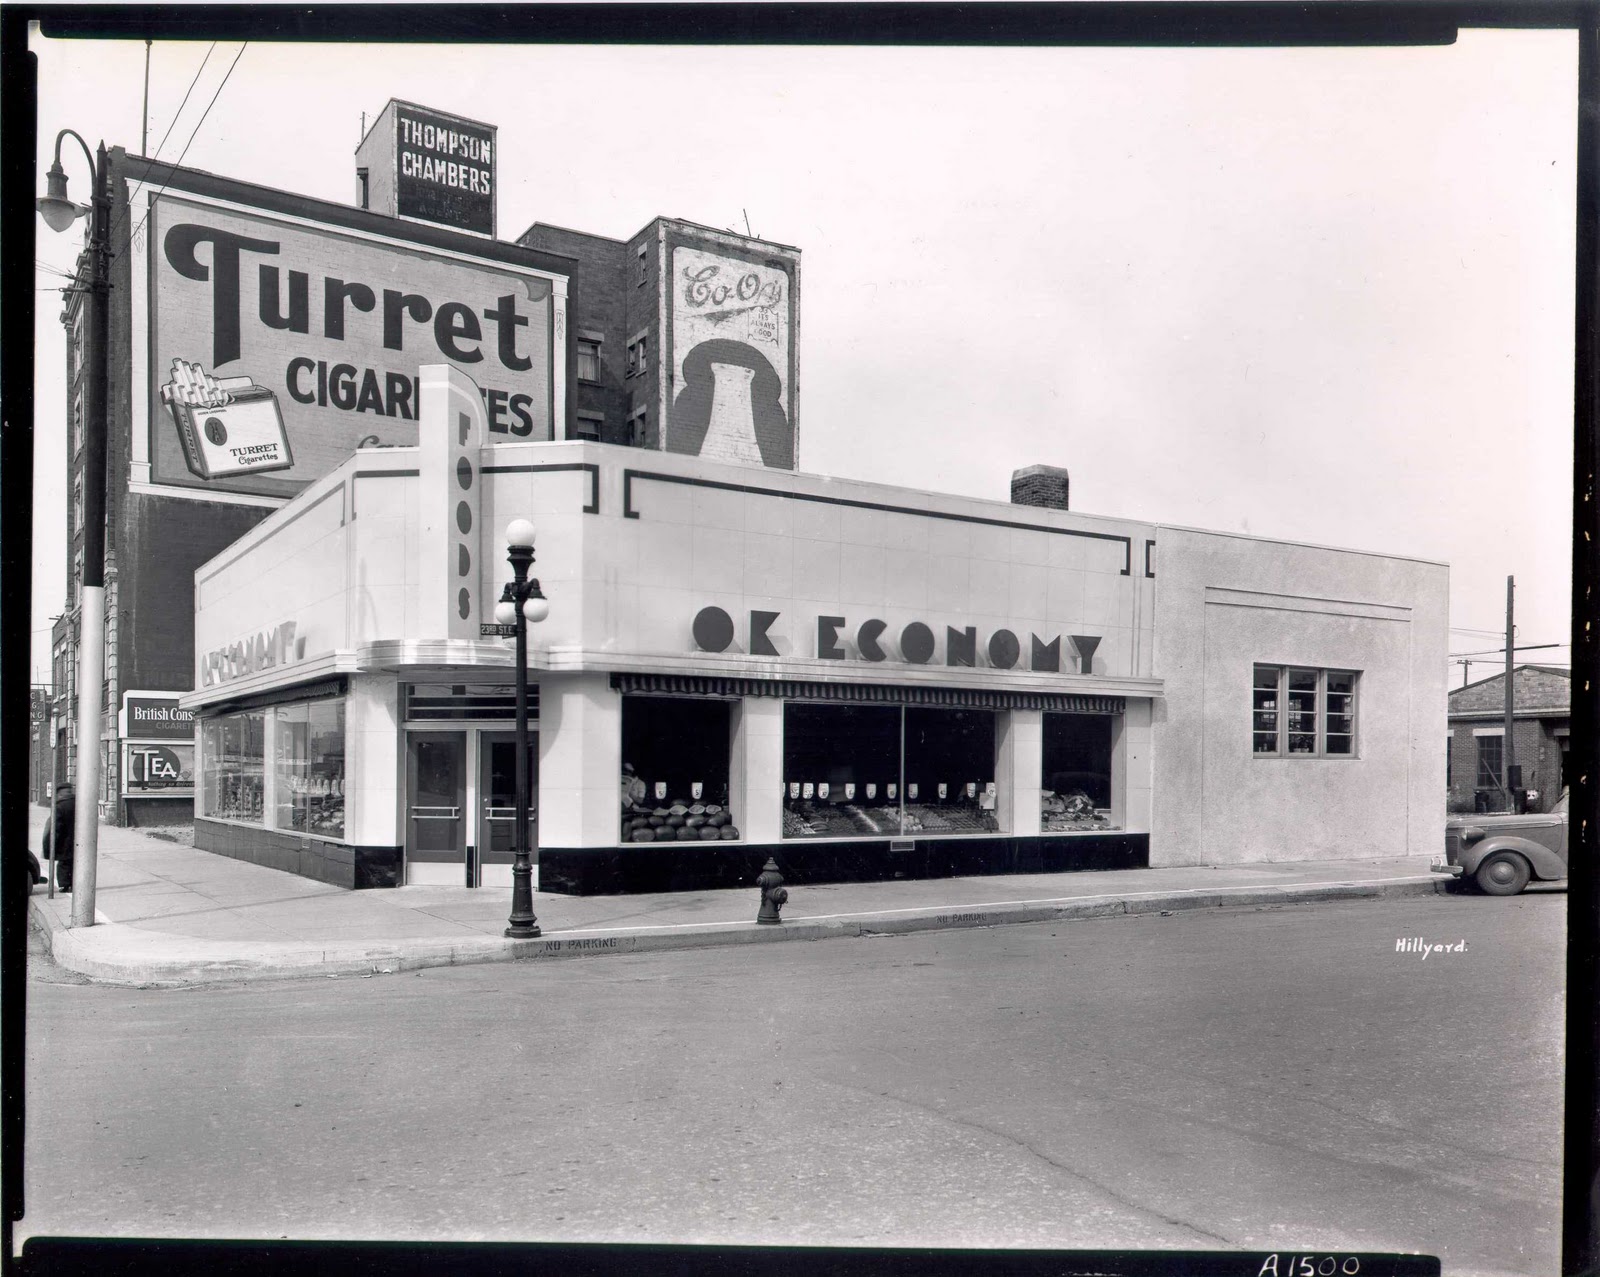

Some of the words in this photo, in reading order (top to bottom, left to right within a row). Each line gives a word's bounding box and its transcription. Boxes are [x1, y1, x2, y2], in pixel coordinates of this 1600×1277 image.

[401, 118, 491, 165] THOMPSON
[402, 151, 491, 195] CHAMBERS
[163, 223, 534, 373] Turret
[230, 443, 279, 457] TURRET
[238, 454, 279, 465] Cigarettes
[457, 411, 473, 620] FOODS
[693, 606, 781, 656] OK
[817, 615, 1102, 674] ECONOMY
[134, 706, 169, 720] British
[952, 912, 987, 923] PARKING
[545, 940, 561, 951] NO
[568, 937, 617, 949] PARKING
